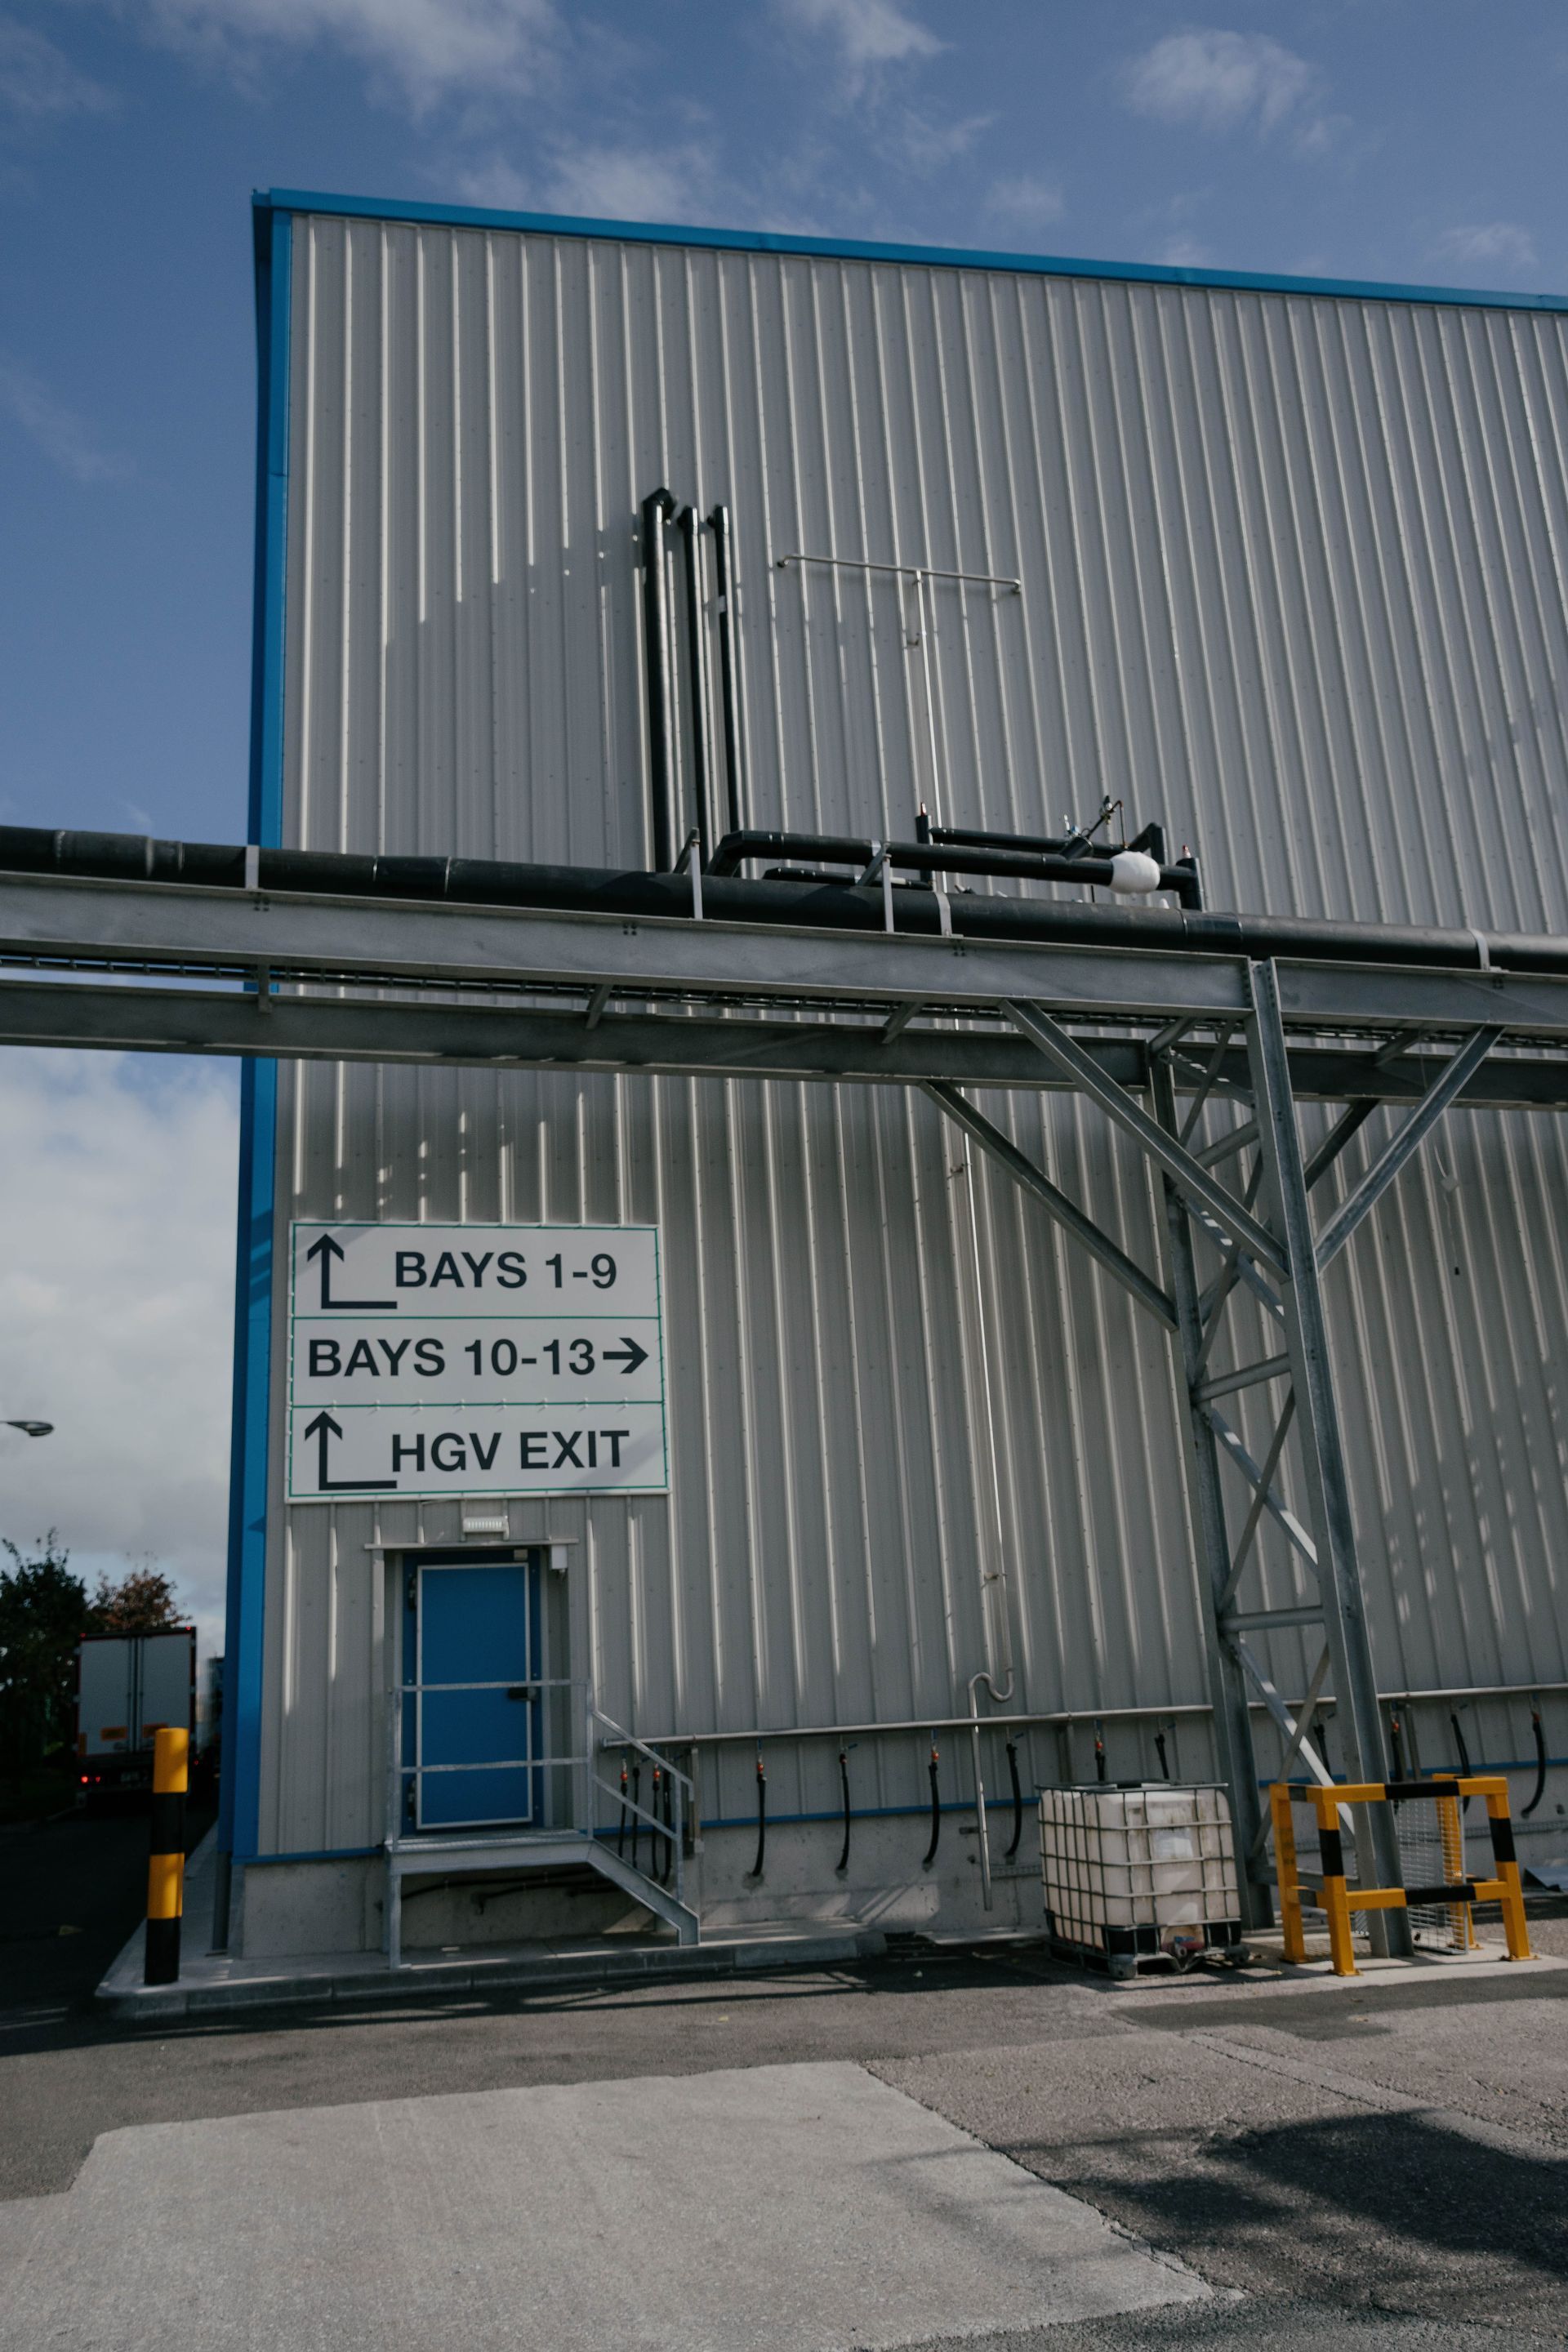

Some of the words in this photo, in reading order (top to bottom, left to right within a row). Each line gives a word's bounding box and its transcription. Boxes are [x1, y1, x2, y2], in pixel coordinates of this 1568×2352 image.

[395, 1251, 528, 1289] BAYS
[545, 1253, 617, 1290] 1-9
[309, 1338, 446, 1378] BAYS
[464, 1339, 596, 1376] 10-13
[392, 1432, 502, 1472] HGV
[519, 1430, 630, 1469] EXIT
